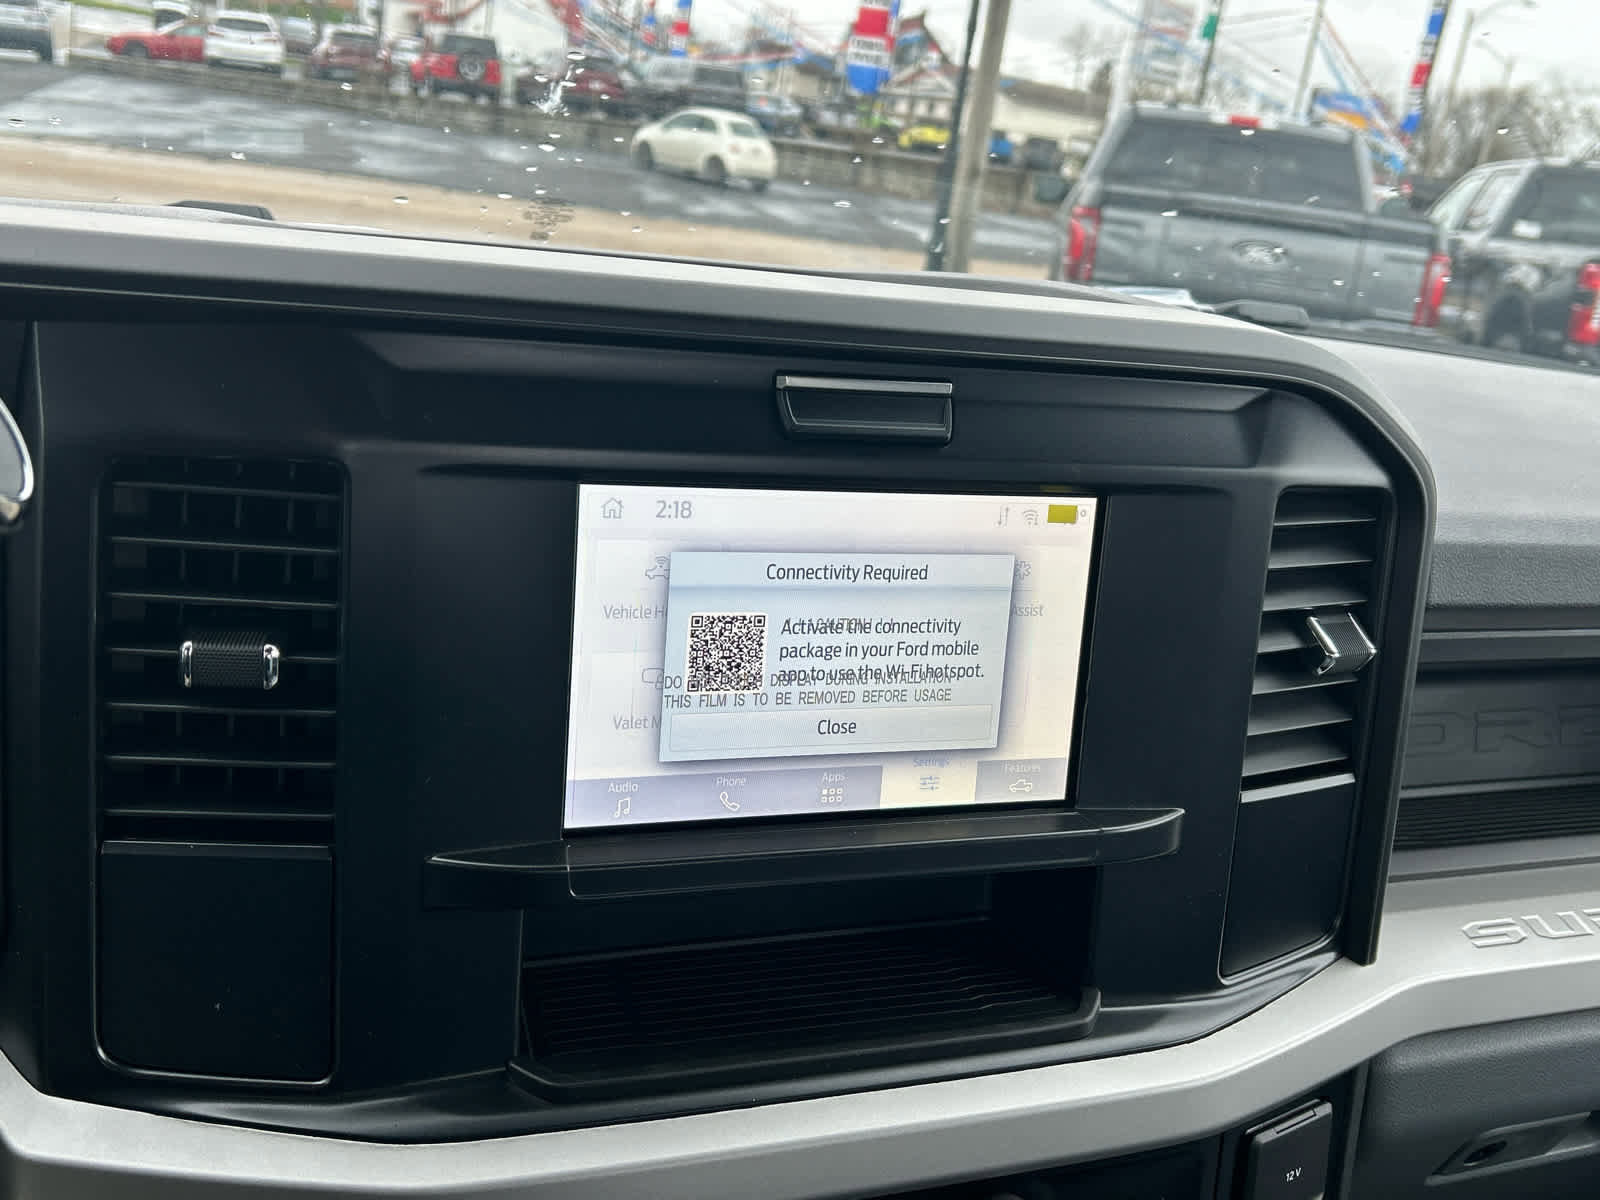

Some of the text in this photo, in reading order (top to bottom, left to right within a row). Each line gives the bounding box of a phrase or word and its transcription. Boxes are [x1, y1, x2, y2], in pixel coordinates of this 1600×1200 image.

[655, 500, 692, 519] 2:18
[766, 563, 929, 583] Connectivity Required
[602, 604, 651, 620] Vehicle
[781, 617, 844, 635] Activate
[848, 617, 872, 634] the
[875, 617, 962, 637] connectivity
[779, 640, 980, 661] package in your Ford mobile
[664, 675, 682, 689] DO
[825, 672, 868, 686] DURING
[875, 670, 952, 684] INSTALLATION
[778, 669, 807, 684] app
[811, 666, 825, 681] to
[829, 668, 855, 681] use
[858, 664, 882, 680] the
[926, 663, 985, 681] hotspot.
[664, 688, 952, 709] THIS FILM IS TO BE REMOVED BEFORE USAGE
[613, 715, 649, 730] Valet
[817, 719, 857, 736] Close
[607, 782, 639, 793] Audio
[715, 776, 747, 788] Phone
